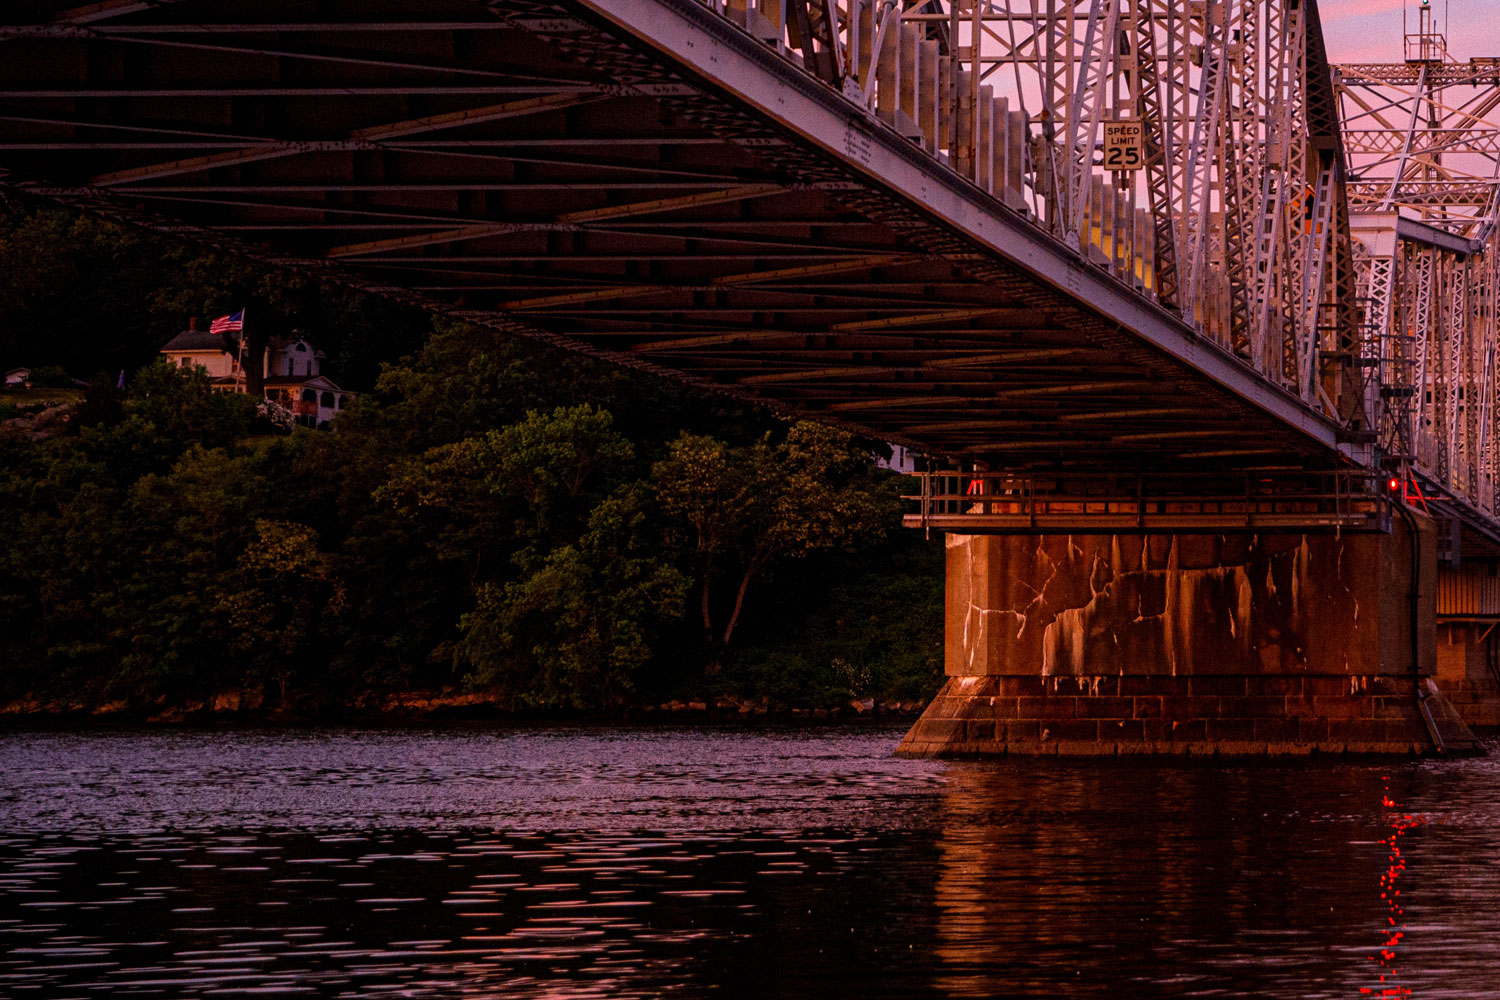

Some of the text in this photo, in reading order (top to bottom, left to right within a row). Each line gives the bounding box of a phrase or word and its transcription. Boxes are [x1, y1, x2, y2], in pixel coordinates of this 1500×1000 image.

[1107, 127, 1140, 135] SPEED
[1111, 137, 1135, 145] LIMIT
[1108, 147, 1139, 165] 25
